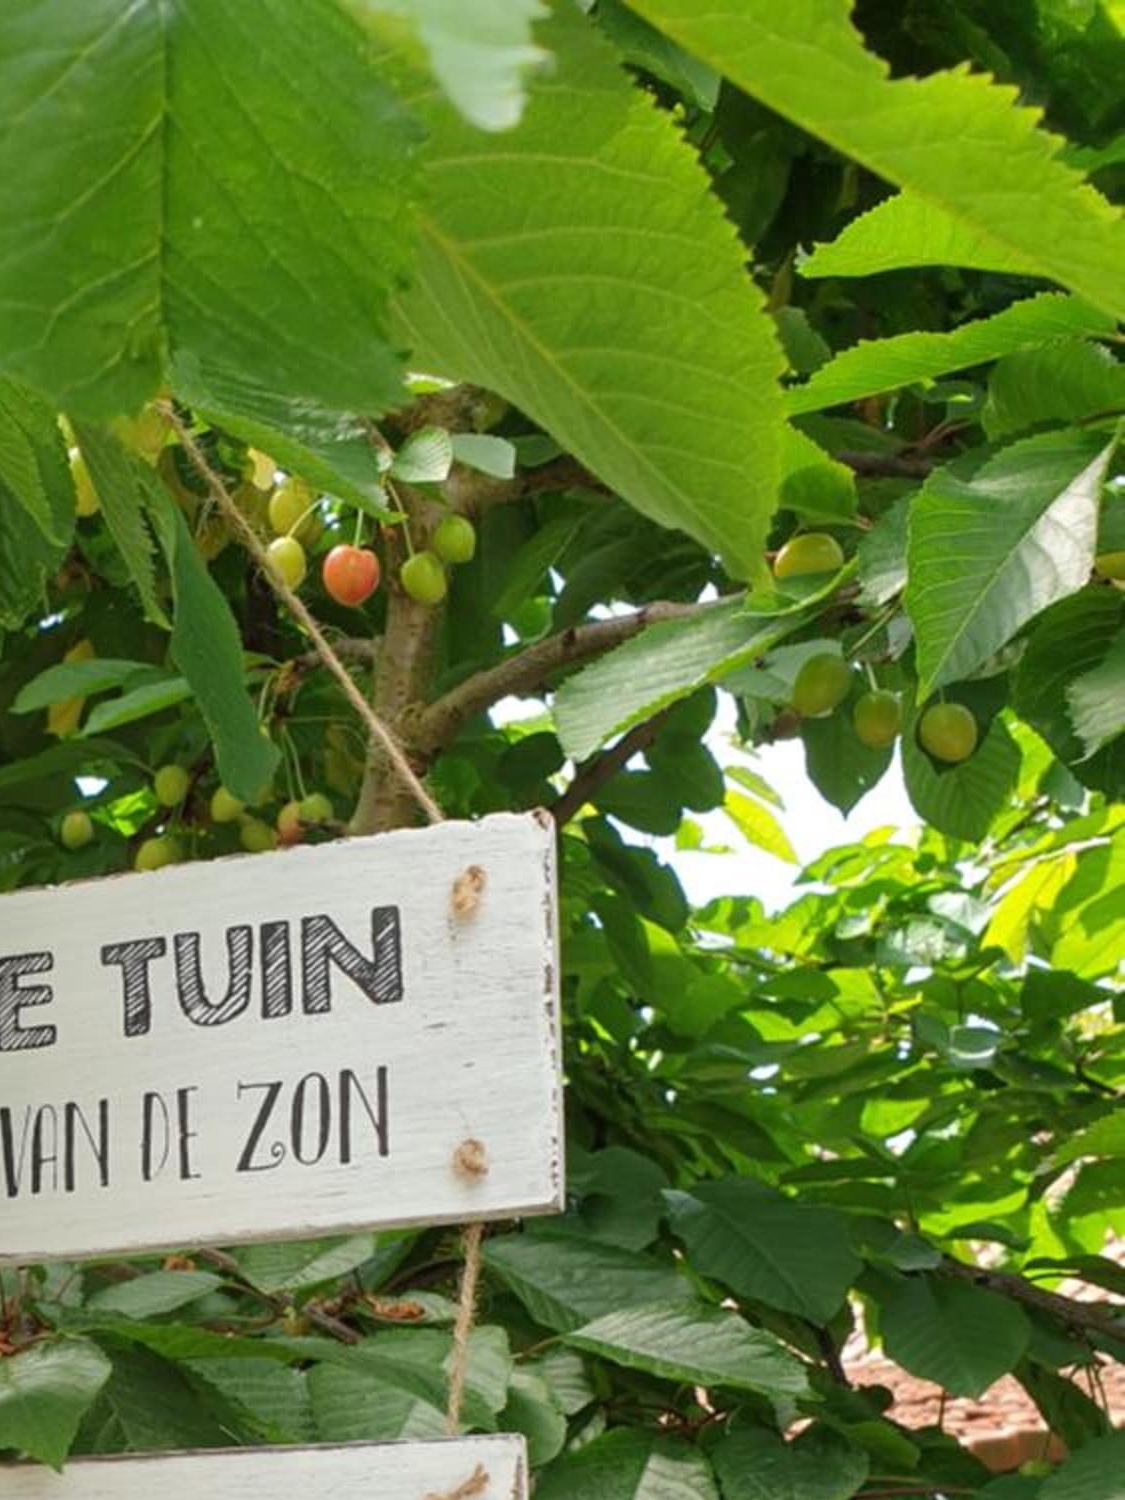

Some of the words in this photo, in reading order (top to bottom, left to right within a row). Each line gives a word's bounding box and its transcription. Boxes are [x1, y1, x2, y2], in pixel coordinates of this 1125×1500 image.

[101, 905, 405, 1037] TUIN
[140, 1087, 202, 1182] DE
[235, 1065, 390, 1173] ZON
